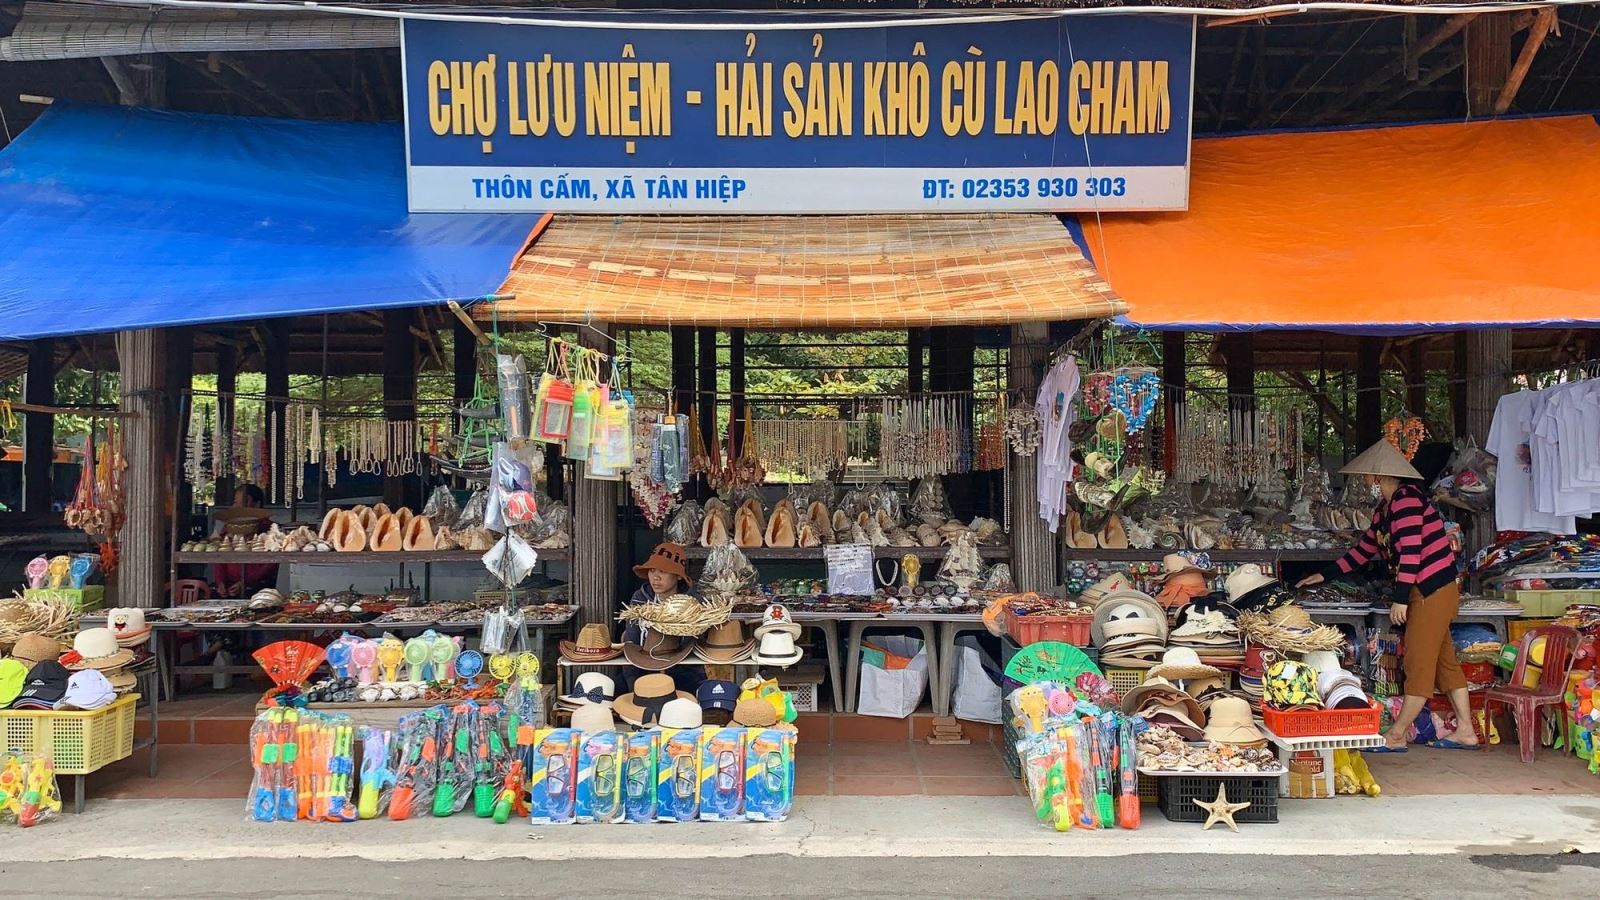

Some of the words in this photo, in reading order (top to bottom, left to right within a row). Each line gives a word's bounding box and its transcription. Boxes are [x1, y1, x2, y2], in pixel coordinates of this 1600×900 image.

[428, 54, 496, 153] CHỢ
[508, 54, 576, 136] LƯU
[584, 44, 671, 153] NIỆM
[716, 33, 773, 136] HẢI
[783, 33, 853, 137] SẢN
[864, 42, 930, 137] KHÔ
[941, 45, 986, 136] CÙ
[995, 60, 1059, 135] LAO
[1068, 60, 1170, 135] CHAM
[472, 175, 532, 198] THÔN
[540, 173, 598, 201] CẤM,
[606, 175, 635, 199] XÃ
[645, 176, 688, 199] TÂN
[695, 175, 746, 202] HIỆP
[922, 178, 955, 199] ĐT:
[962, 178, 1030, 198] 02353
[1038, 177, 1078, 197] 930
[1086, 177, 1126, 197] 303
